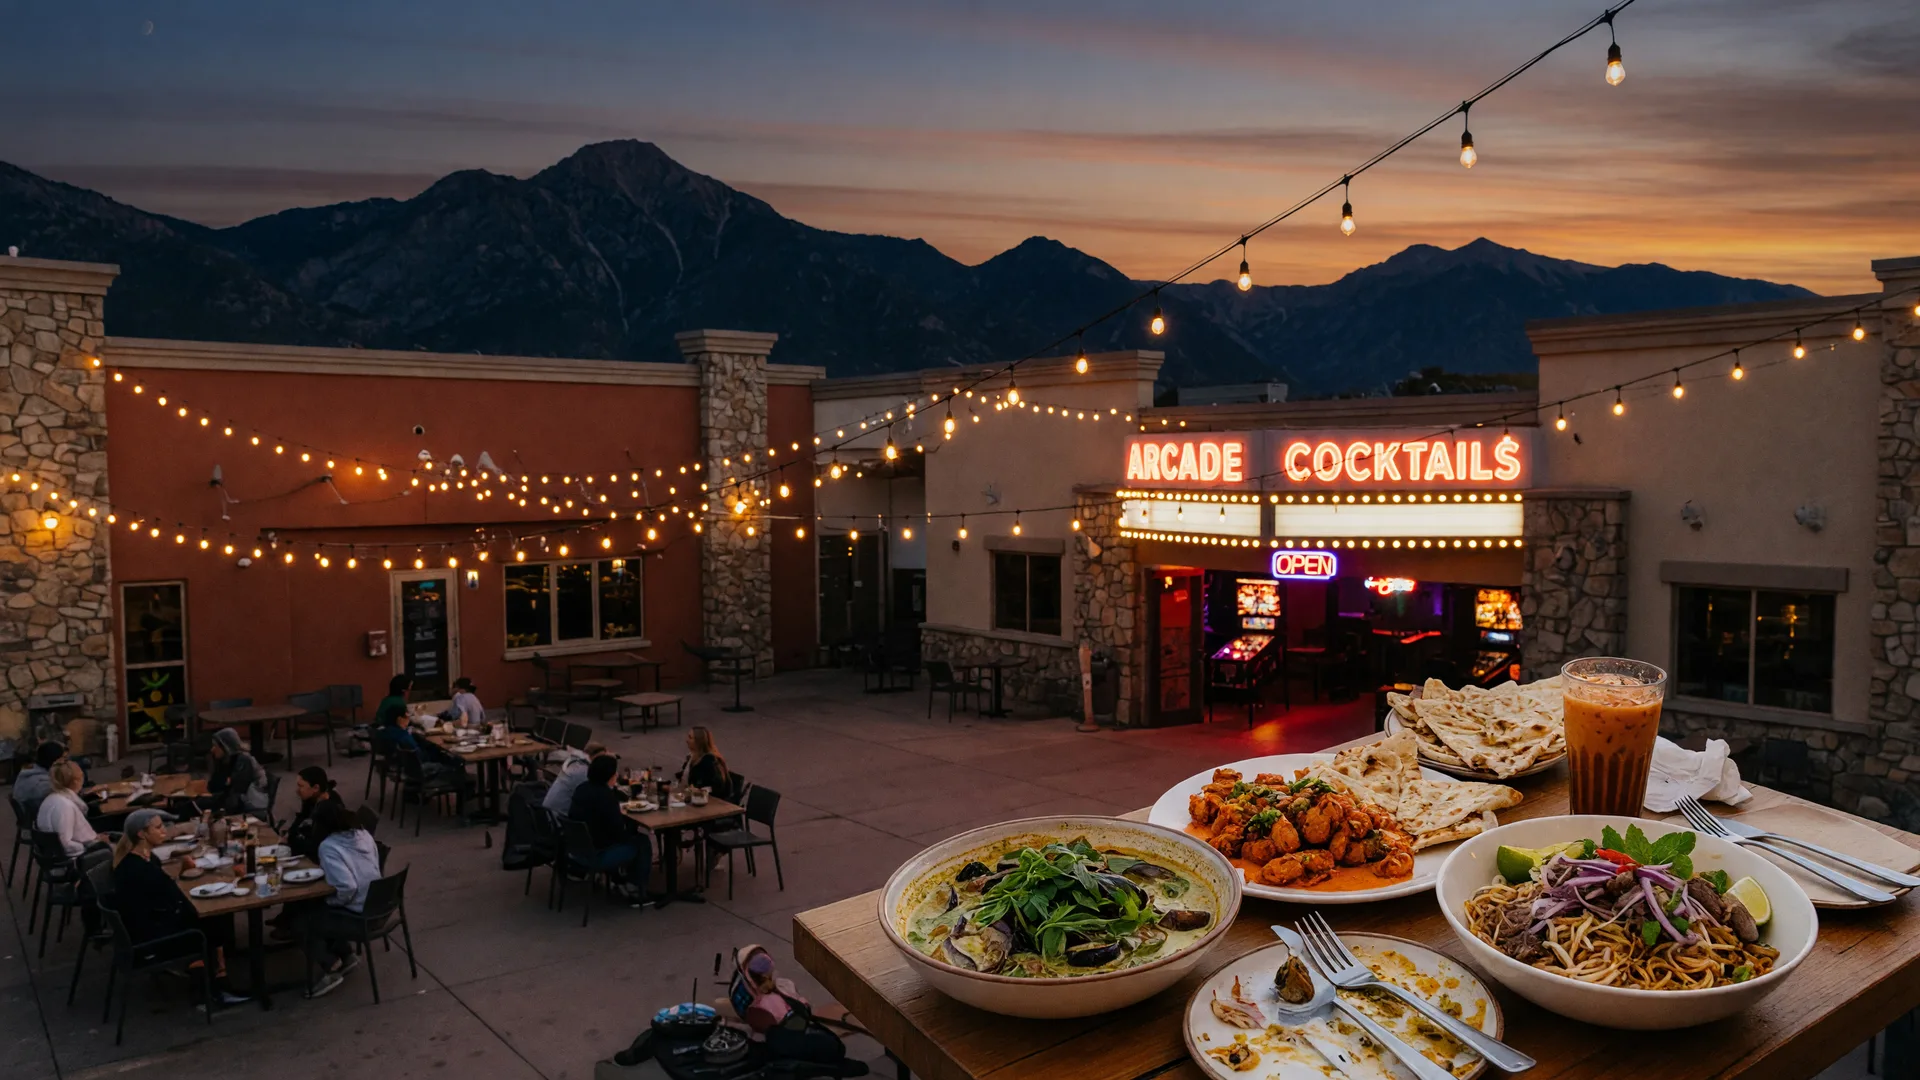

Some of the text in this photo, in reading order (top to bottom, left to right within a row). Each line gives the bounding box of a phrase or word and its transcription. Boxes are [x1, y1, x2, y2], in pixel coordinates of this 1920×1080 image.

[1126, 441, 1521, 482] ARCADE COCKTAILS
[1276, 554, 1332, 575] OPEN
